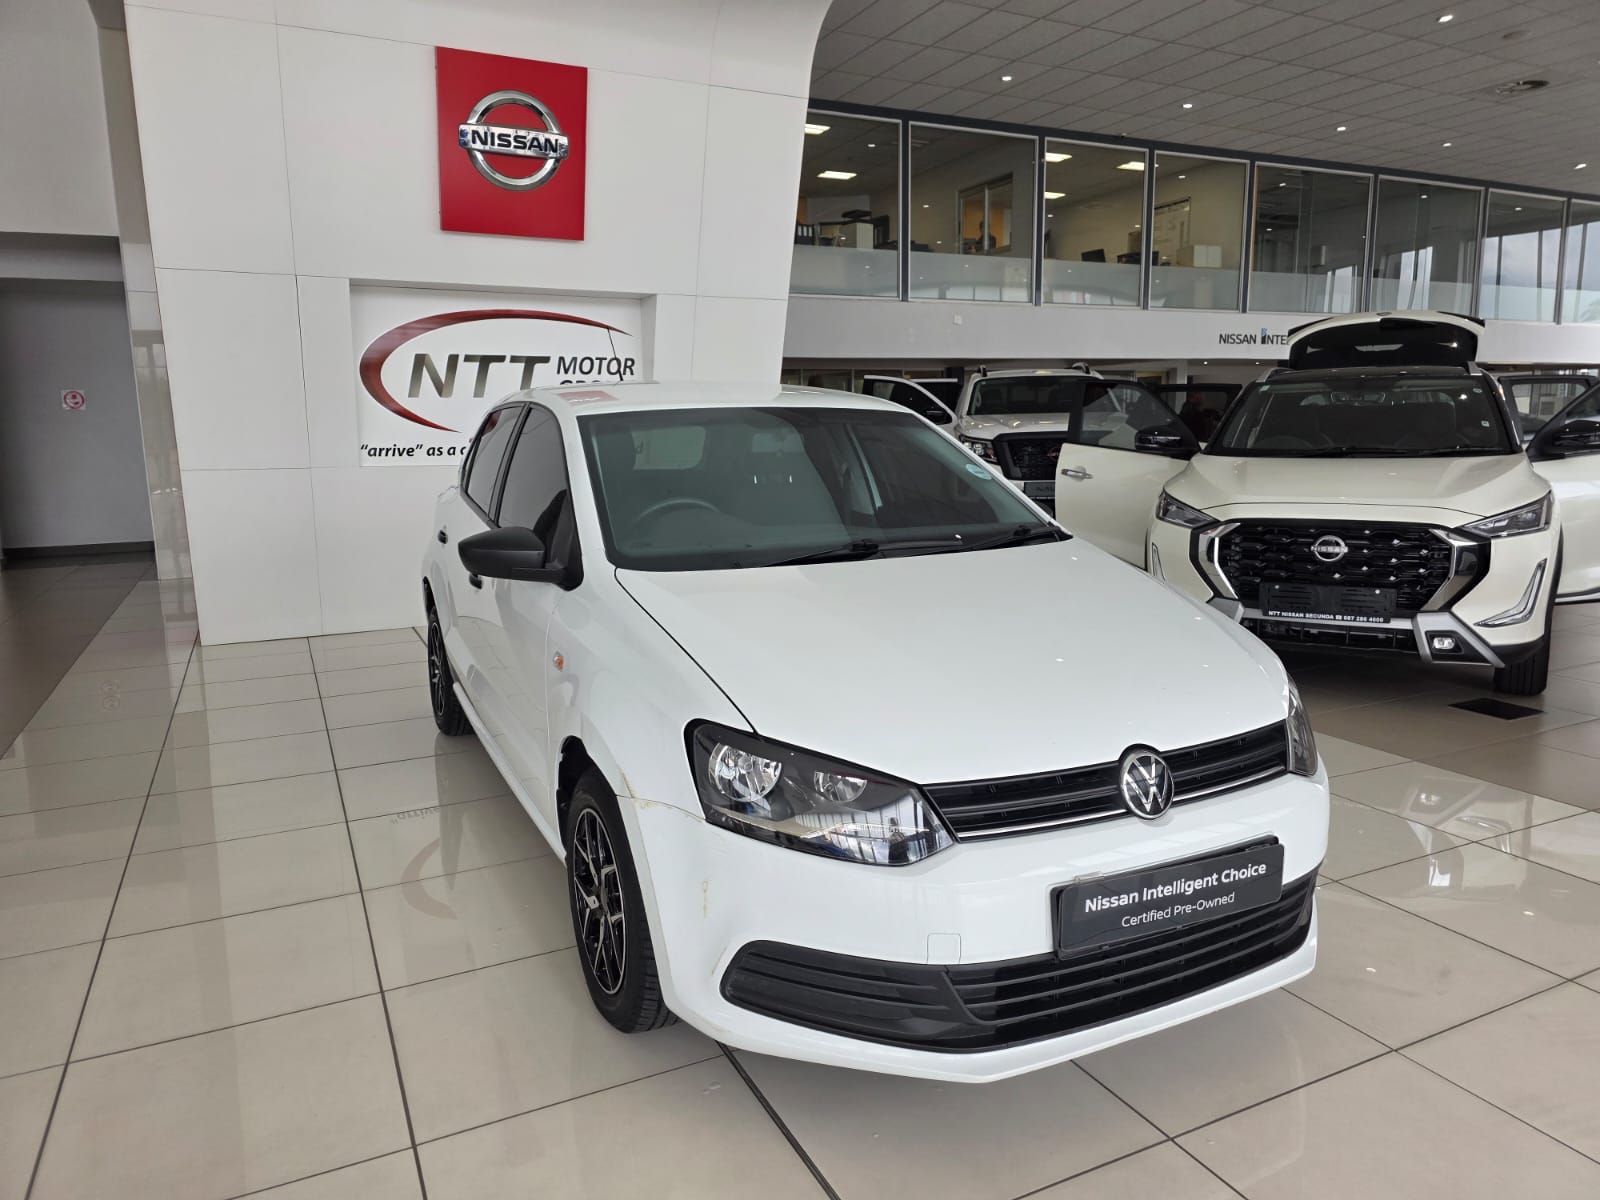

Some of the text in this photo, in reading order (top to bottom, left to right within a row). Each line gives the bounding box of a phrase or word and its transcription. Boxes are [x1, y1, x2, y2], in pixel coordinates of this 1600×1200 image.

[470, 129, 560, 154] NISSAN
[1218, 333, 1257, 345] NISSAN
[408, 353, 551, 398] NTT
[556, 355, 635, 376] MOTOR
[426, 446, 443, 457] as
[447, 446, 457, 456] a
[1305, 612, 1334, 620] SECUNDA
[1085, 862, 1267, 914] Nissan Intelligent Choice
[1121, 891, 1235, 928] Certified Pre-Owned
